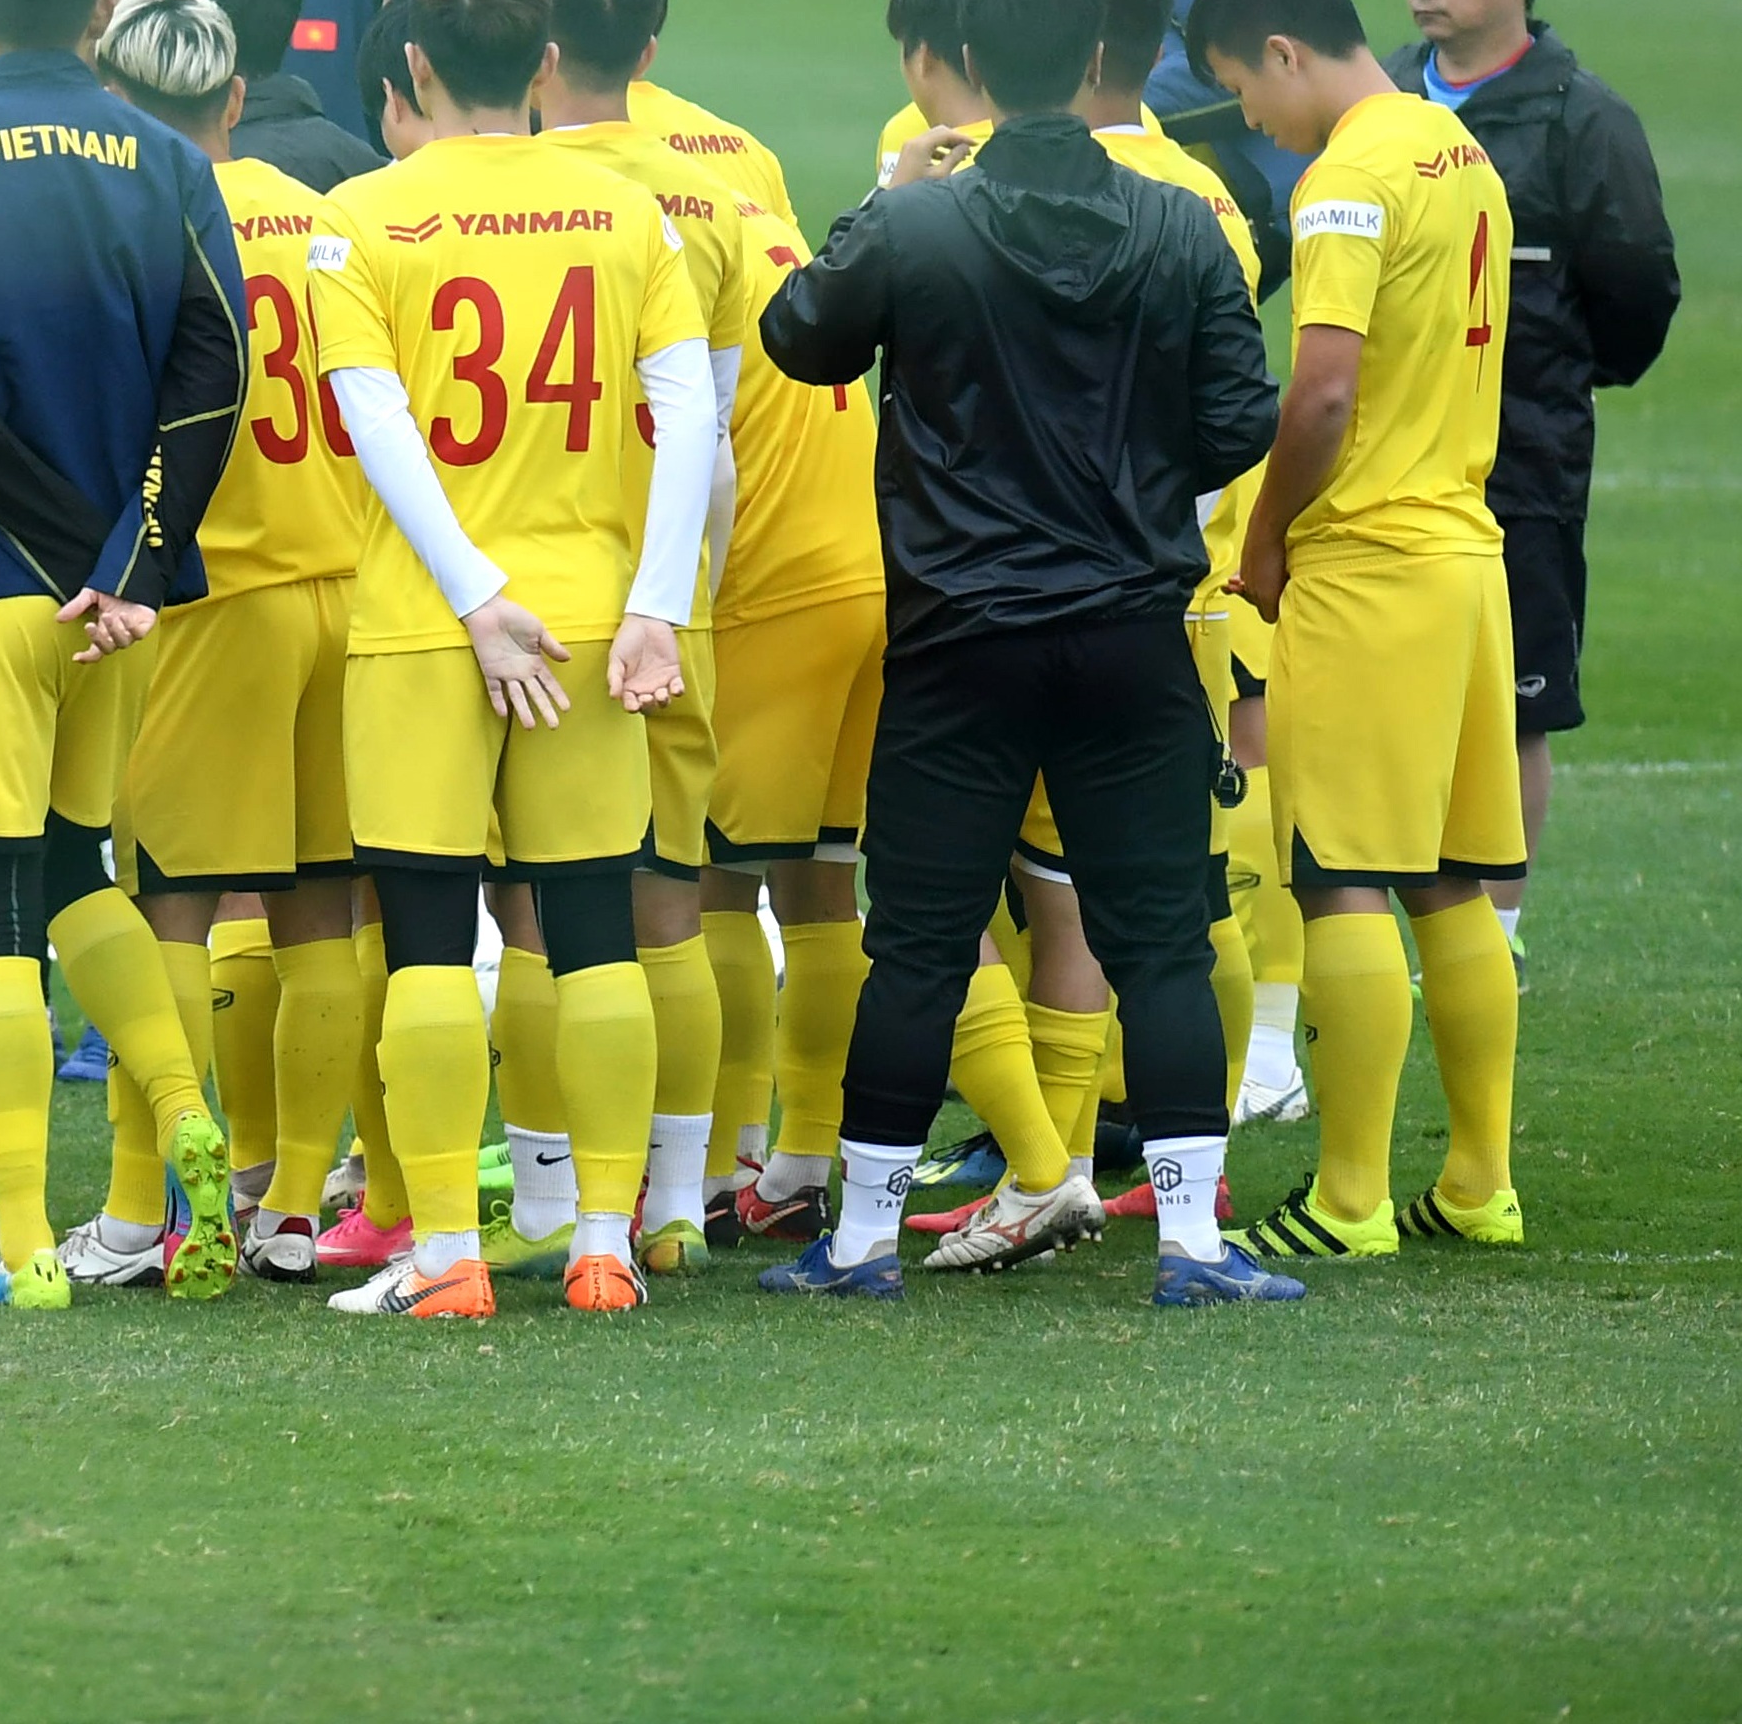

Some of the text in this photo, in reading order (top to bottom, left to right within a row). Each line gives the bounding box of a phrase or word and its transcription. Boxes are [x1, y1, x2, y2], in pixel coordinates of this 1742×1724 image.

[662, 133, 747, 155] ANMAR
[659, 195, 714, 221] MAR
[451, 209, 614, 235] YANMAR
[428, 266, 603, 467] 34
